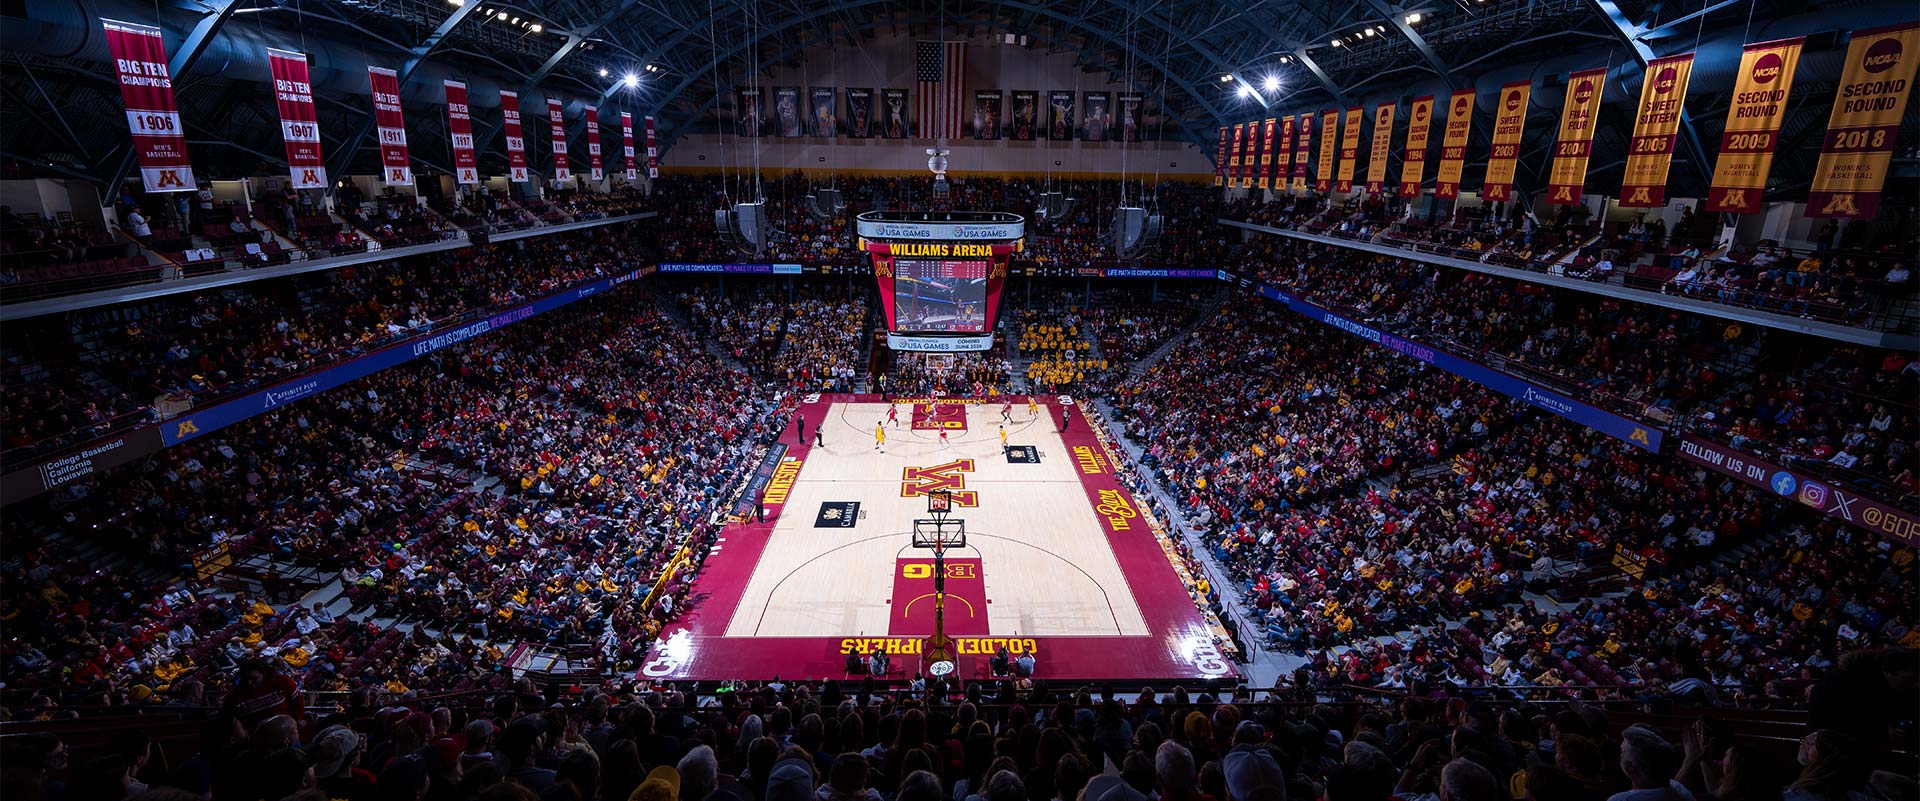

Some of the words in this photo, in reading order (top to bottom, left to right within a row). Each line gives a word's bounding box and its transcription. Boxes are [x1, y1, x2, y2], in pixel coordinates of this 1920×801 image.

[117, 58, 142, 74] BIG
[141, 61, 168, 77] TEN
[1754, 67, 1779, 78] NCAA
[121, 75, 171, 88] CHAMPIONS
[276, 79, 292, 92] BIG
[293, 82, 310, 94] TEN
[1843, 79, 1906, 97] SECOND
[278, 93, 312, 103] CHAMPIONS
[374, 92, 386, 101] BIG
[387, 95, 399, 104] TEN
[1736, 90, 1784, 104] SECOND
[1645, 99, 1677, 111] SWEET
[1736, 105, 1778, 118] ROUND
[1844, 97, 1896, 113] ROUND
[1500, 116, 1520, 125] SWEET
[1569, 109, 1590, 119] FINAL
[1640, 112, 1677, 124] SIXTEEN
[137, 115, 174, 131] 1906
[1568, 120, 1587, 130] FOUR
[289, 125, 313, 138] 1907
[383, 130, 401, 142] 1911
[1496, 126, 1520, 135] SIXTEEN
[1635, 138, 1667, 152] 2005
[1728, 133, 1770, 149] 2009
[1834, 129, 1886, 149] 2018
[1408, 151, 1423, 160] 1994
[1494, 146, 1514, 157] 2003
[1559, 143, 1585, 155] 2004
[1833, 164, 1872, 172] WOMEN'S
[885, 229, 900, 237] USA
[902, 229, 931, 237] GAMES
[963, 230, 979, 238] USA
[980, 230, 1008, 238] GAMES
[889, 243, 949, 256] WILLIAMS
[952, 244, 993, 257] ARENA
[660, 264, 671, 272] LIFE
[672, 264, 685, 272] MATH
[685, 264, 690, 272] IS
[1107, 269, 1118, 277] LIFE
[1118, 269, 1130, 277] MATH
[1131, 269, 1136, 277] IS
[413, 341, 428, 356] LIFE
[429, 336, 446, 351] MATH
[446, 333, 453, 345] IS
[452, 320, 491, 342] COMPLICATED.
[491, 317, 500, 329] WE
[1324, 313, 1333, 324] LIFE
[1333, 315, 1345, 328] MATH
[1344, 320, 1349, 331] IS
[1349, 322, 1380, 343] COMPLICATED.
[1381, 334, 1390, 346] WE
[1390, 337, 1405, 353] MAKE
[1405, 341, 1412, 353] IT
[47, 455, 80, 470] College
[81, 439, 124, 459] Basketball
[1680, 440, 1723, 466] FOLLOW
[1727, 457, 1743, 473] US
[1747, 465, 1766, 482] ON
[49, 459, 92, 478] California
[51, 466, 94, 486] Louisville
[841, 502, 856, 527] CAMBRIA
[1109, 515, 1131, 531] THE
